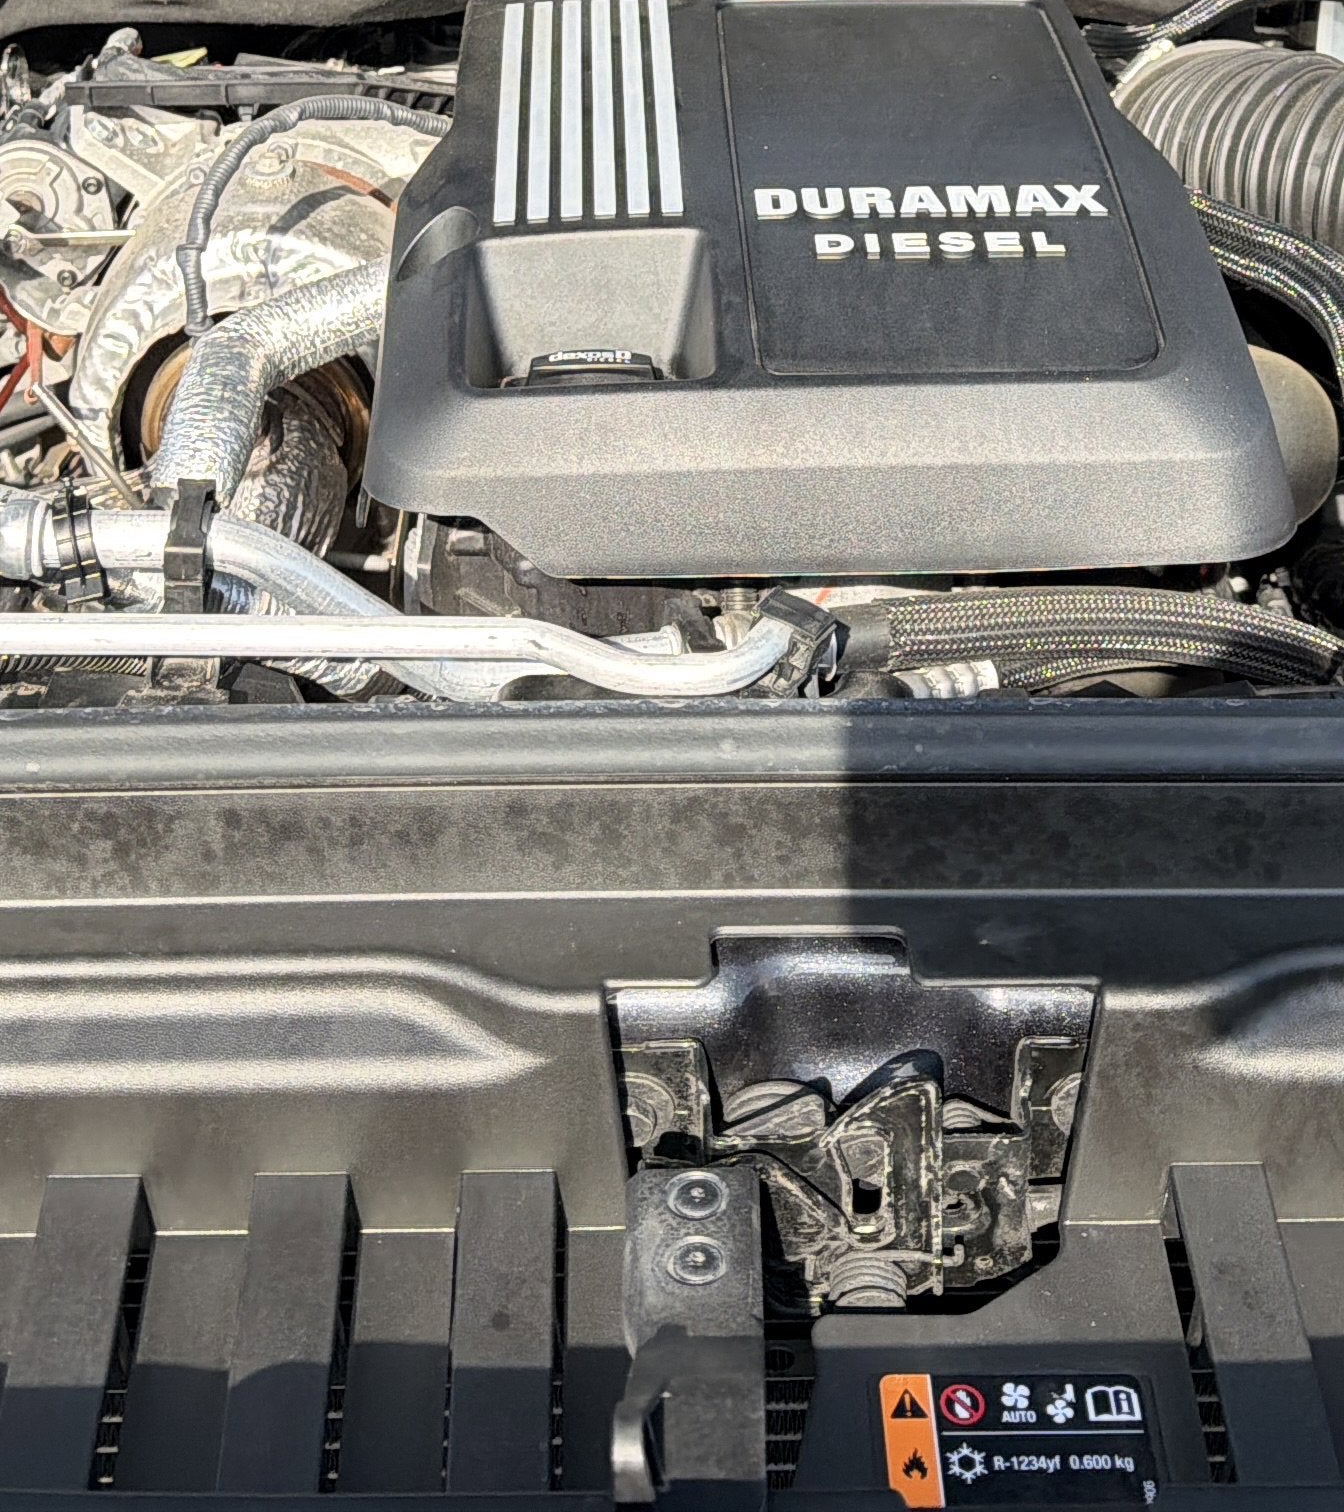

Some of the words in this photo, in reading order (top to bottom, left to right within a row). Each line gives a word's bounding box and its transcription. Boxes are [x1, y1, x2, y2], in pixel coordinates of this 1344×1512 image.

[753, 184, 1109, 219] DURAMAX
[813, 231, 1067, 260] DIESEL
[1001, 1410, 1037, 1423] AUTO
[993, 1454, 1061, 1473] R-1234yf
[1069, 1454, 1112, 1470] 0.600
[1114, 1453, 1136, 1473] kg
